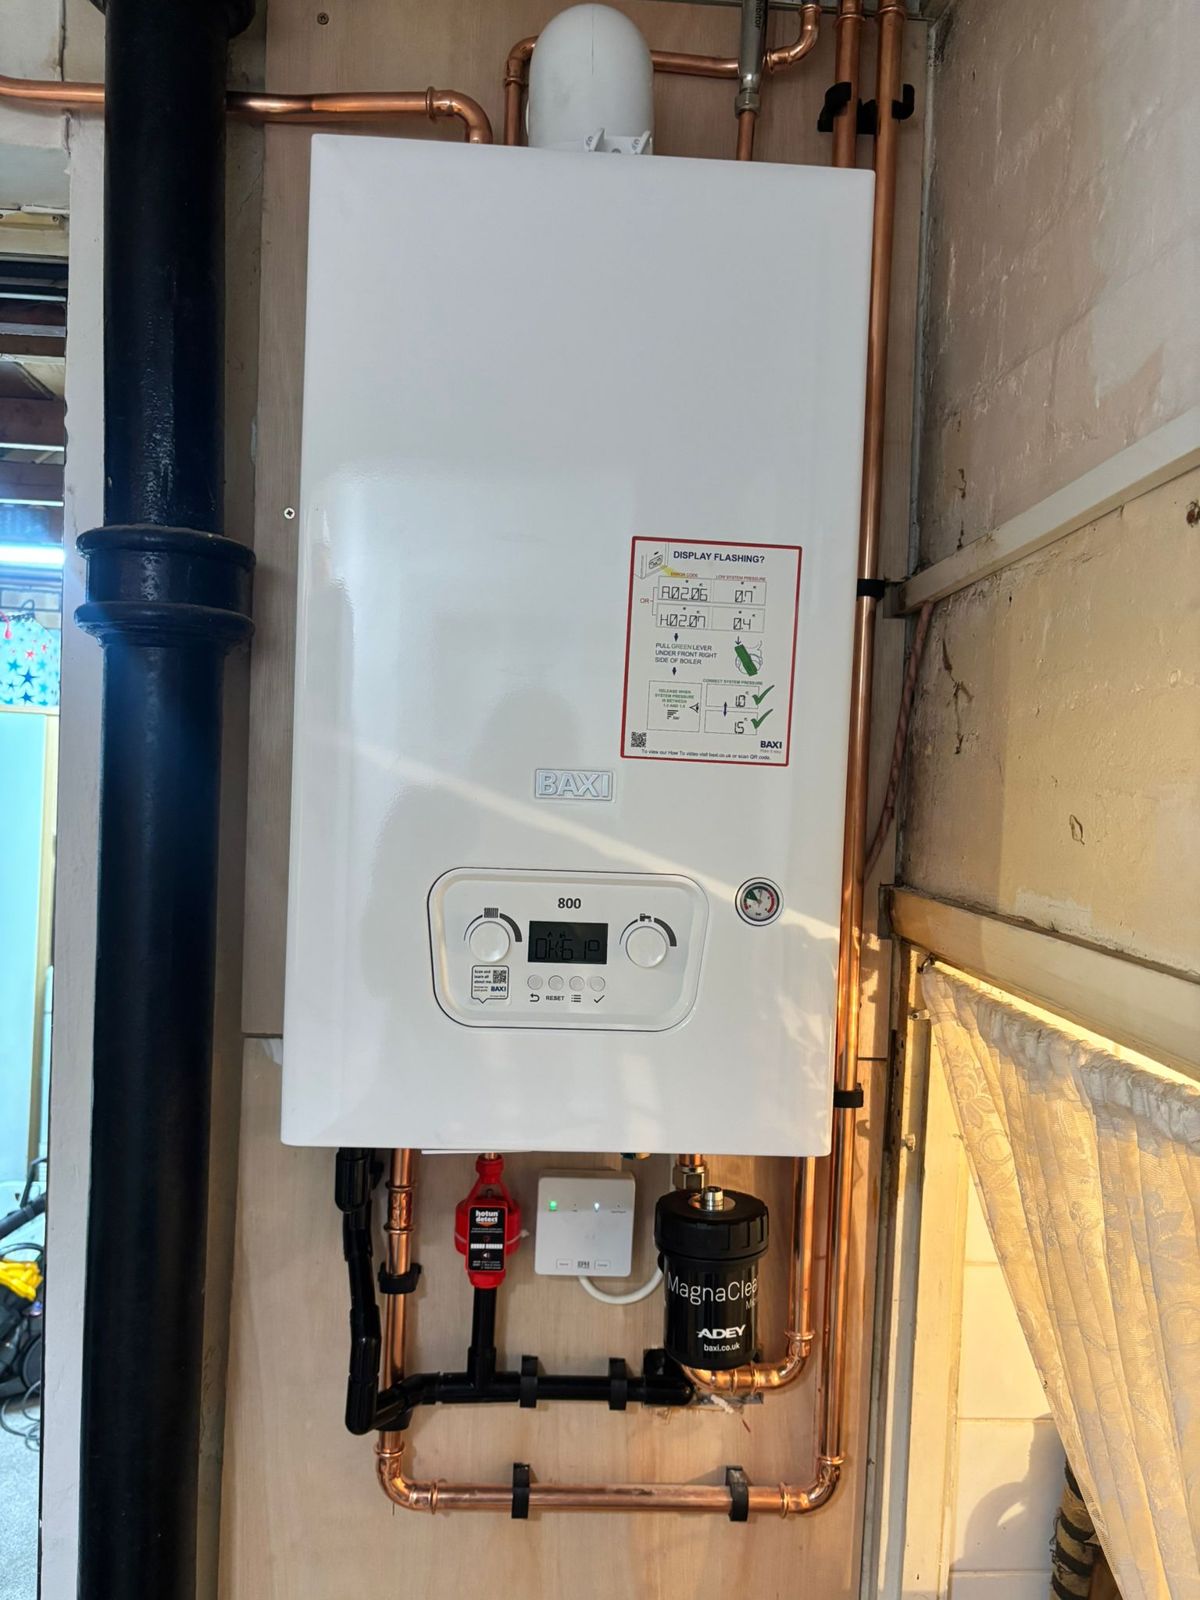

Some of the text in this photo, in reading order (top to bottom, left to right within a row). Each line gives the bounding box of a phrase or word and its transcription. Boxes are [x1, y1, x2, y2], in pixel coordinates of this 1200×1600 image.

[673, 551, 765, 563] DISPLAY FLASHING?
[760, 740, 782, 749] BAXI
[538, 771, 610, 798] BAXI
[557, 897, 582, 909] 800
[475, 1209, 499, 1217] hotun
[475, 1215, 498, 1223] detect
[696, 1324, 746, 1339] ADEY
[703, 1342, 741, 1352] baxi.co.uk
